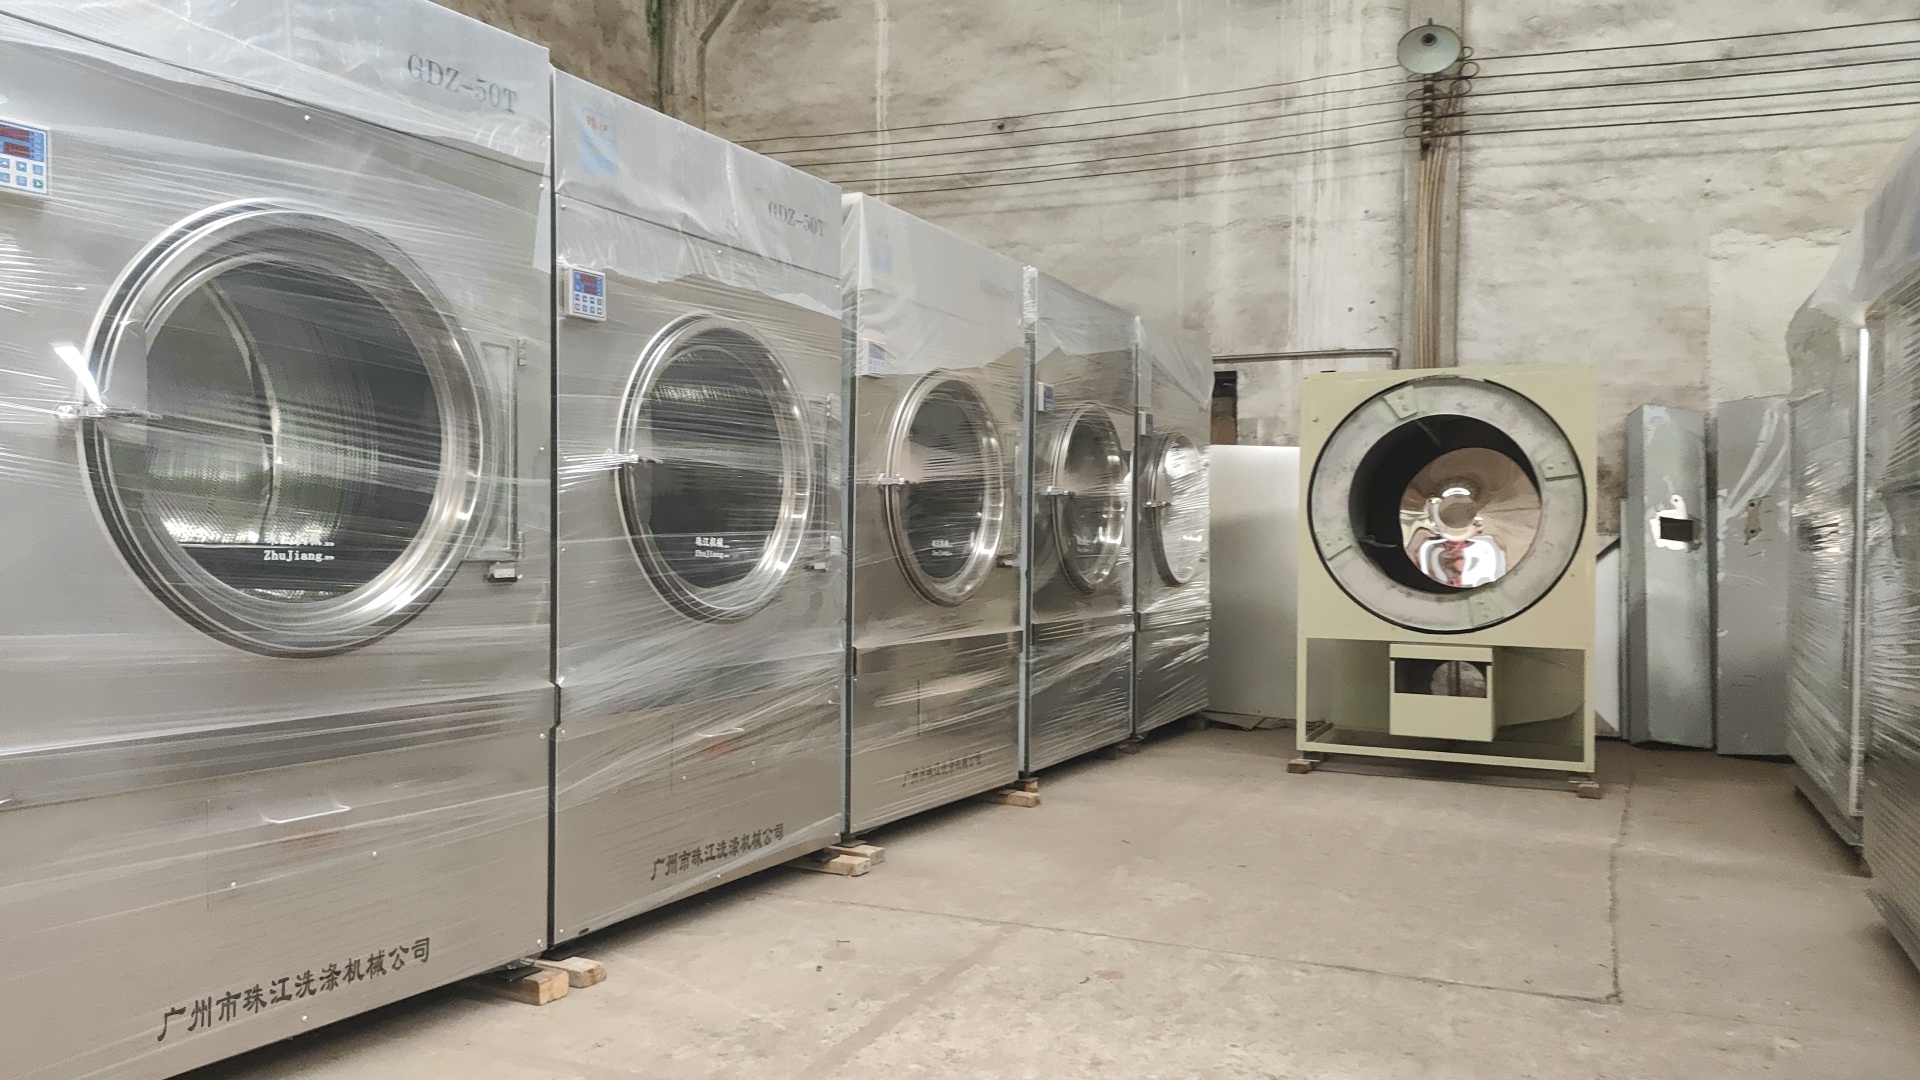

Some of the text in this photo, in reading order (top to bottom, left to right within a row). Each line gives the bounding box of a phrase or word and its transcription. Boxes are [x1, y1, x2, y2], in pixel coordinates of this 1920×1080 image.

[408, 54, 517, 113] GDZ-50T
[768, 201, 825, 236] GDZ-50T
[263, 549, 323, 562] ZhuJiang
[650, 822, 784, 881] 广州市珠江洗涤机械公司
[157, 936, 431, 1042] 广州市珠江洗涤机械公司
